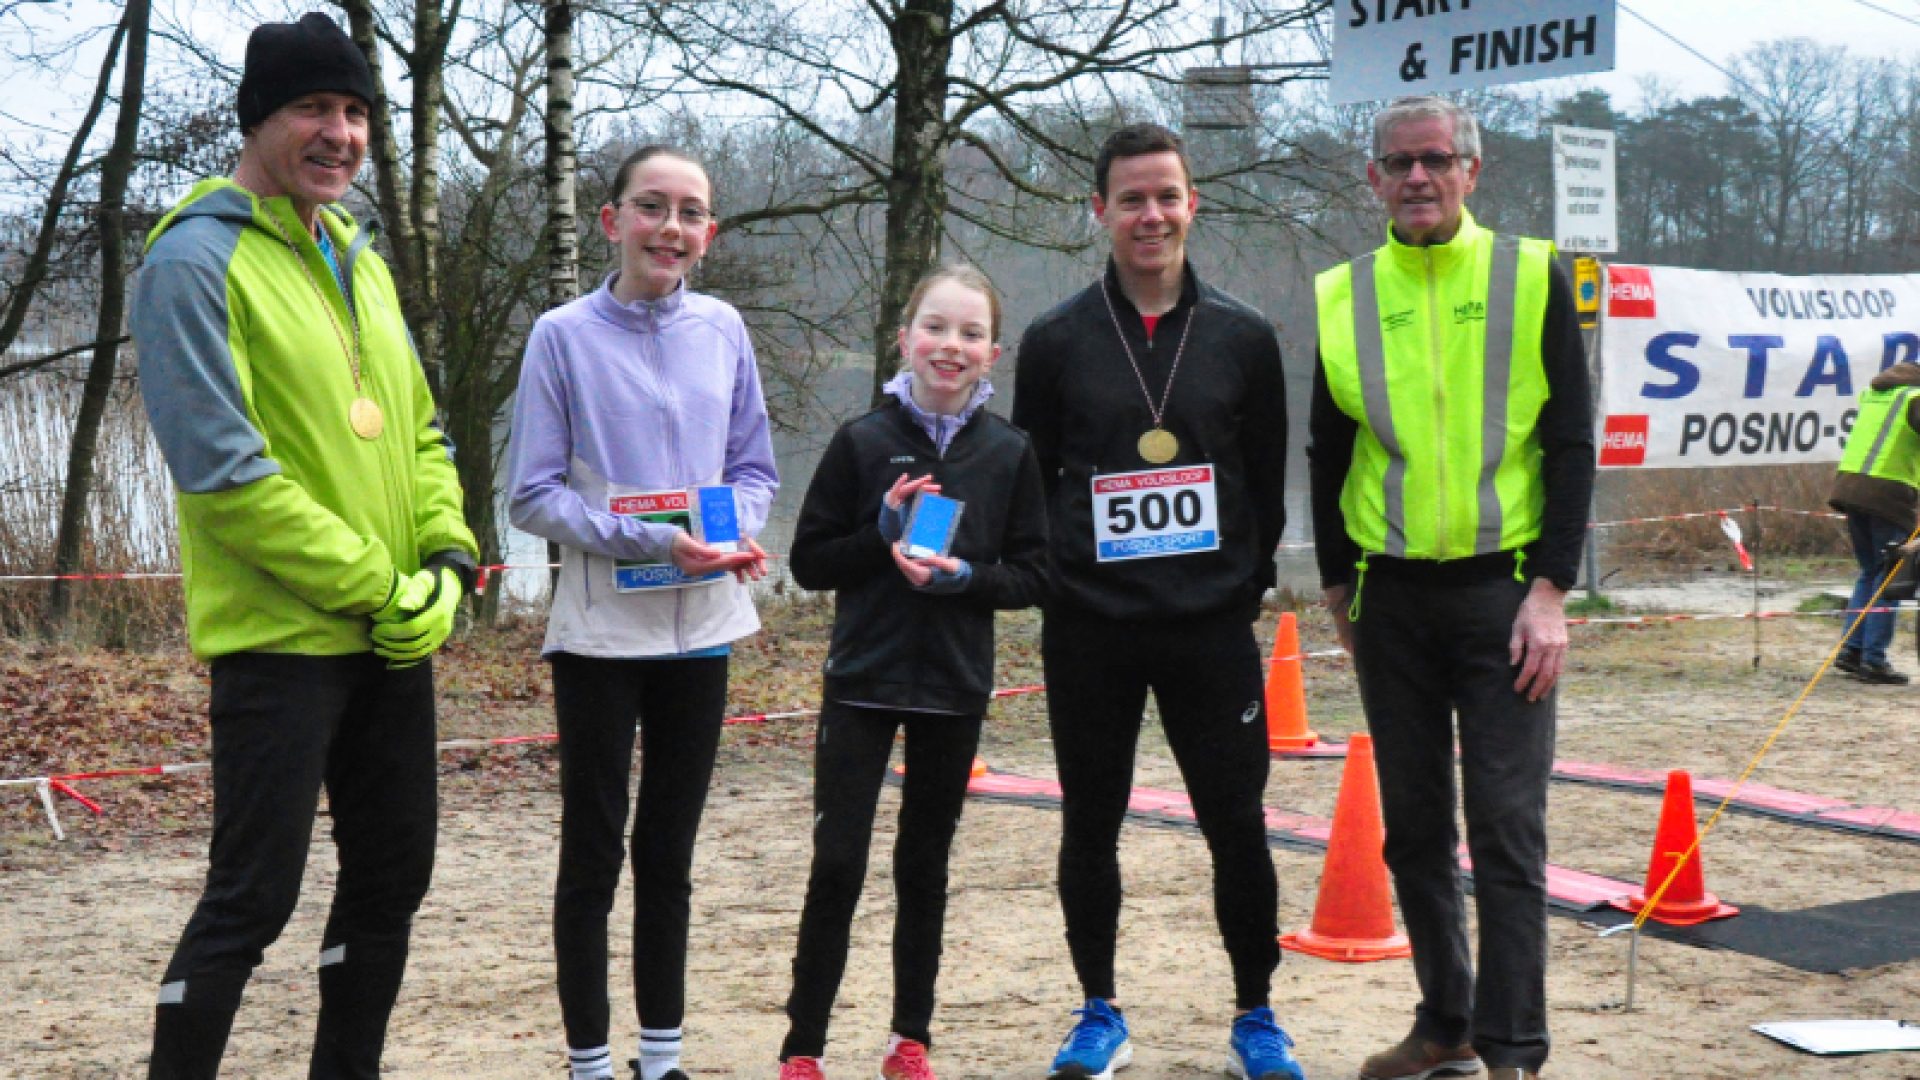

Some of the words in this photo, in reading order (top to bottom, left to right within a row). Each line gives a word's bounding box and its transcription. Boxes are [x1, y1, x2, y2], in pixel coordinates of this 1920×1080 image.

[1400, 42, 1427, 82] &
[1451, 15, 1597, 74] FINISH
[1609, 282, 1653, 301] HEMA
[1747, 287, 1897, 320] VOLKSLOOP
[1603, 431, 1647, 450] HEMA
[618, 497, 656, 513] HEMA
[1108, 489, 1202, 534] 500
